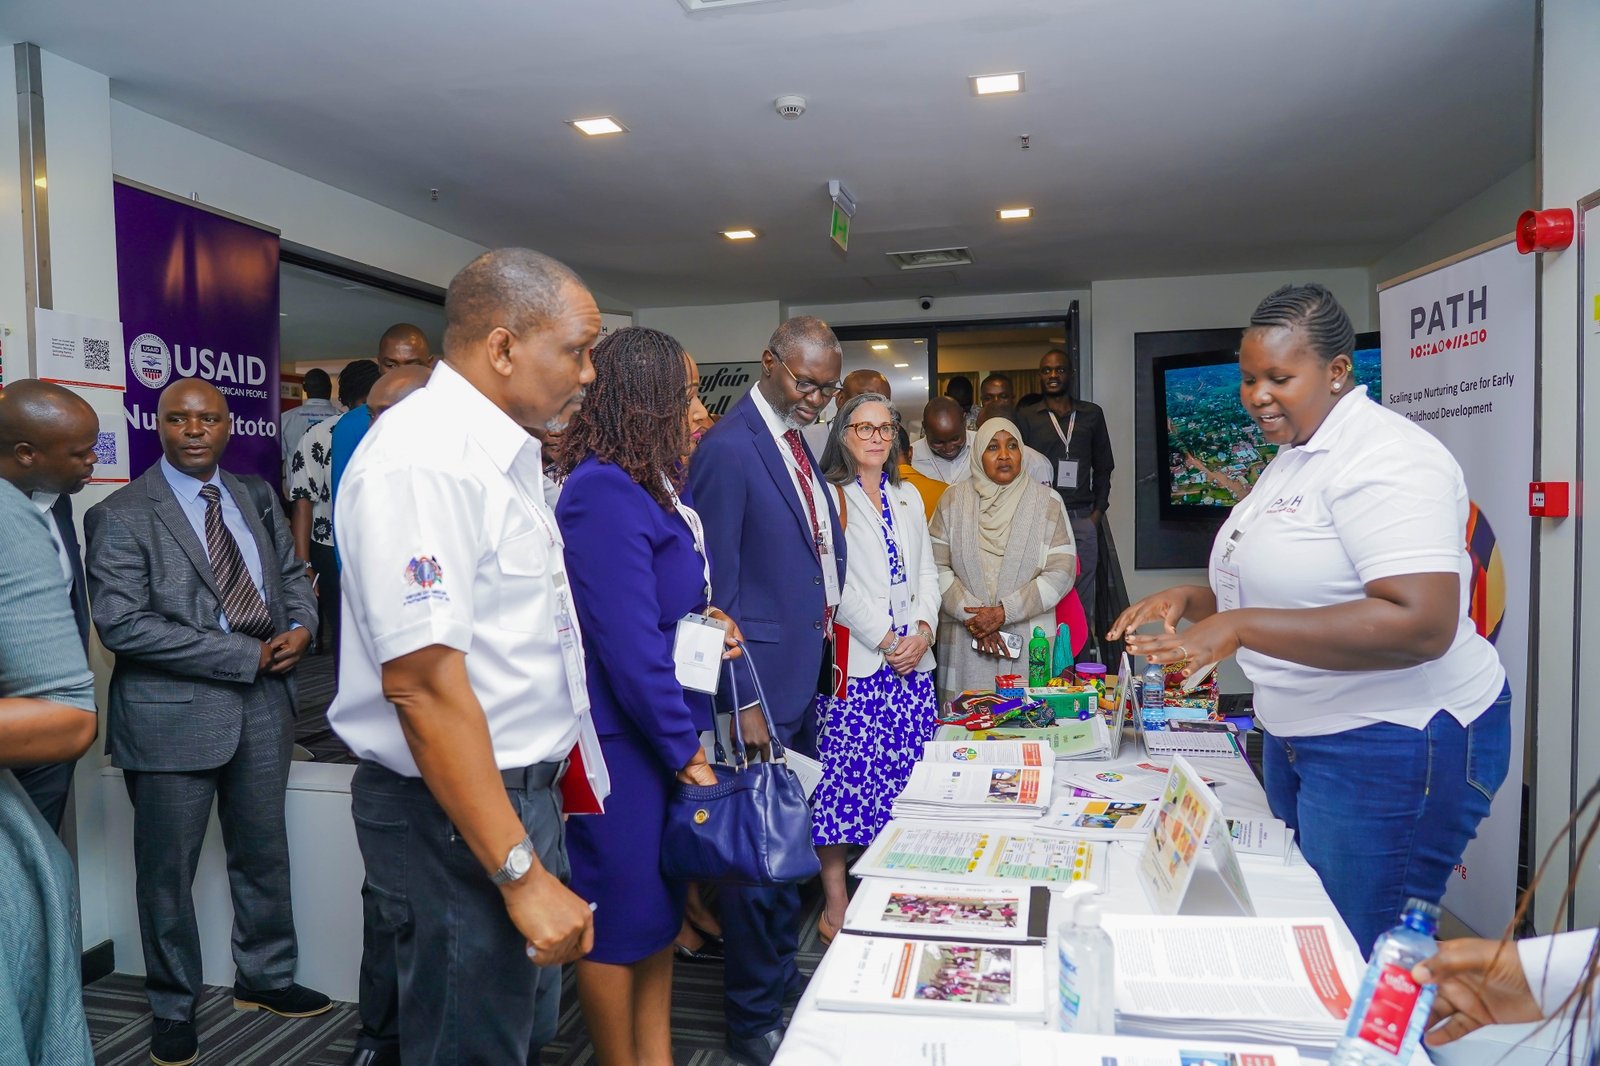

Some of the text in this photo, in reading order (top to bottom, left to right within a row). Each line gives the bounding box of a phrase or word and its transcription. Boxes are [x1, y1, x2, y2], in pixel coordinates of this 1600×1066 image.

[1410, 285, 1487, 340] PATH
[174, 344, 267, 386] USAID
[215, 386, 268, 399] MERICAN PEOPLE
[698, 367, 750, 393] yfair
[1389, 372, 1515, 404] Scaling up Nurturing Care for Early
[697, 395, 732, 415] all
[1441, 401, 1493, 418] Development
[123, 404, 277, 437] Nu toto
